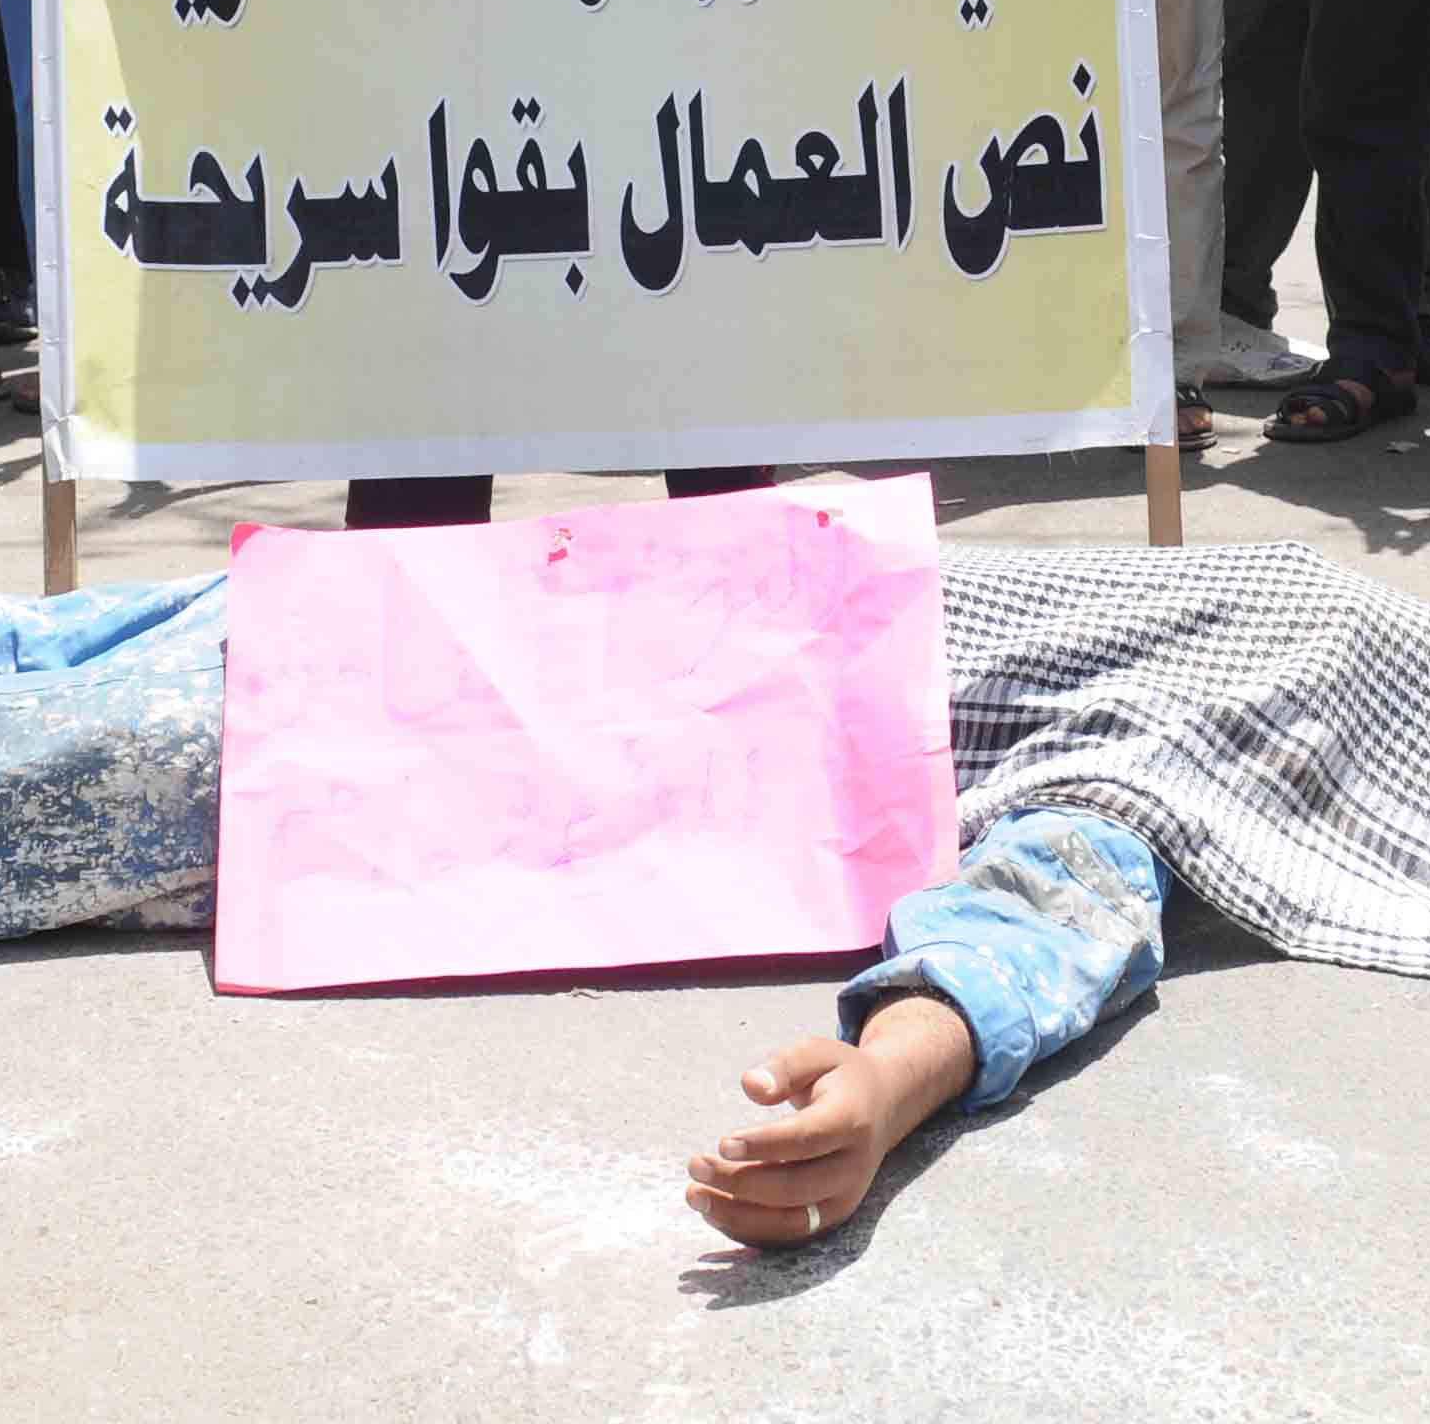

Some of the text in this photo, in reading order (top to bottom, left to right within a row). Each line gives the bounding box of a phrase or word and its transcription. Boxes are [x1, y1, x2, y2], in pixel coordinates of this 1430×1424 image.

[102, 61, 1105, 310] نص العمال بقوا سريحة
